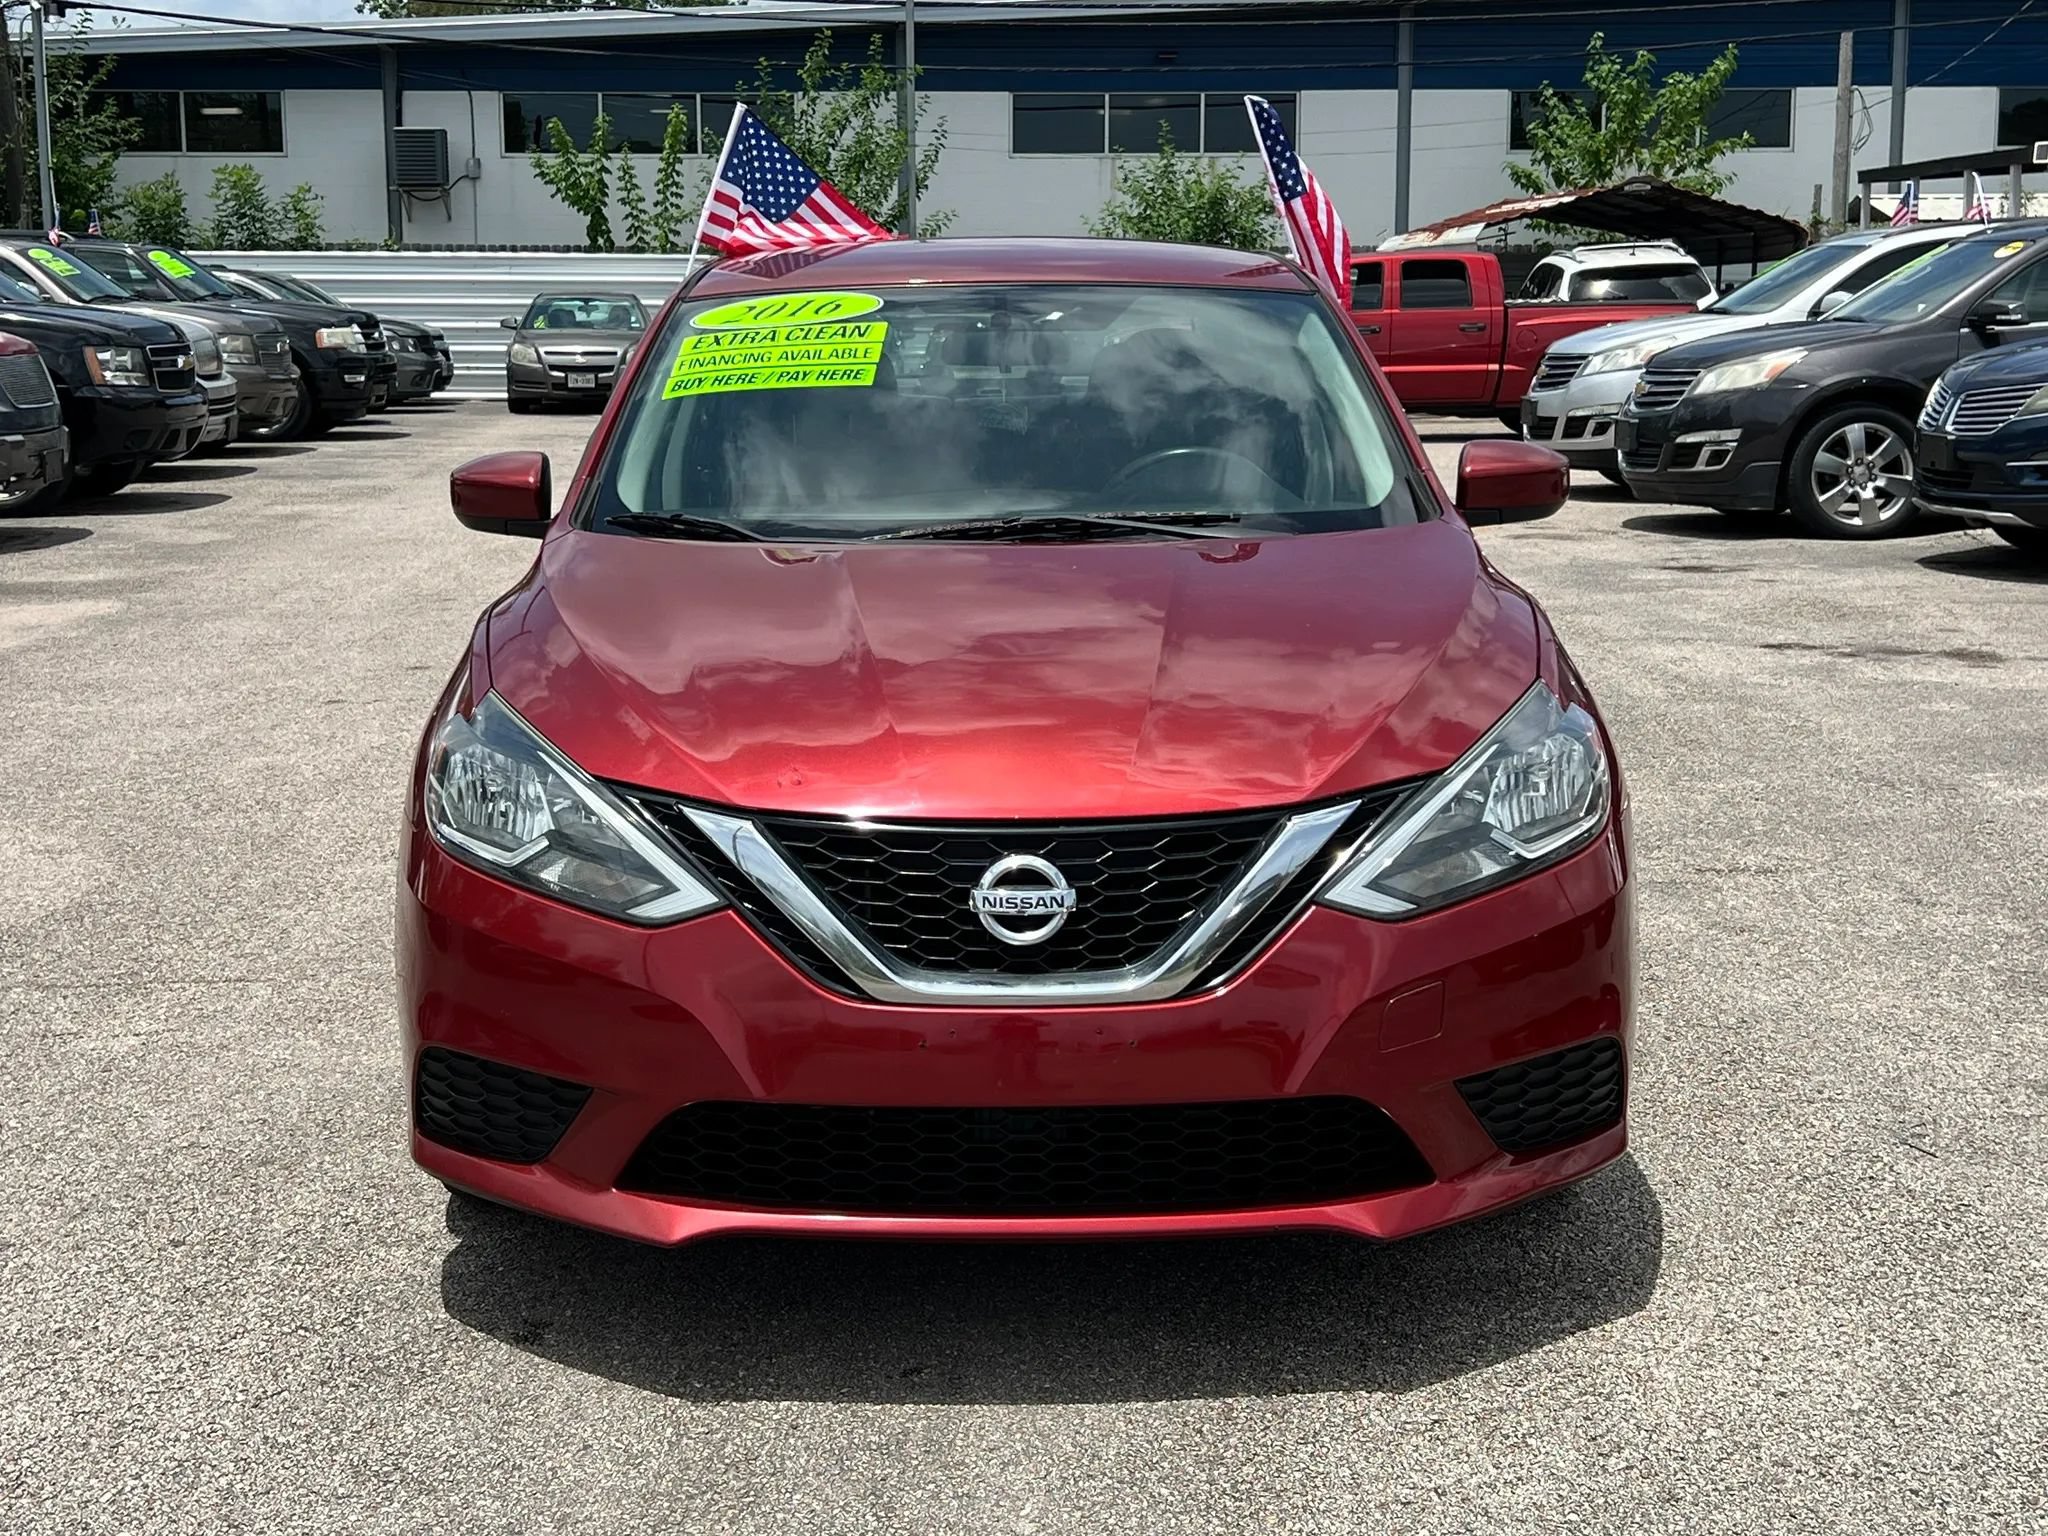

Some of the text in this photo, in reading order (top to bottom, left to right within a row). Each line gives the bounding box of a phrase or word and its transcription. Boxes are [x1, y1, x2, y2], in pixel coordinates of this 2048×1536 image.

[720, 297, 846, 325] 2016
[692, 325, 871, 350] EXTRA CLEAN
[679, 348, 873, 371] FINANCING AVAILABLE
[671, 376, 708, 392] BUY
[711, 373, 761, 387] HERE
[776, 370, 813, 382] PAY
[816, 369, 866, 381] HERE
[982, 895, 1065, 910] NISSAN
